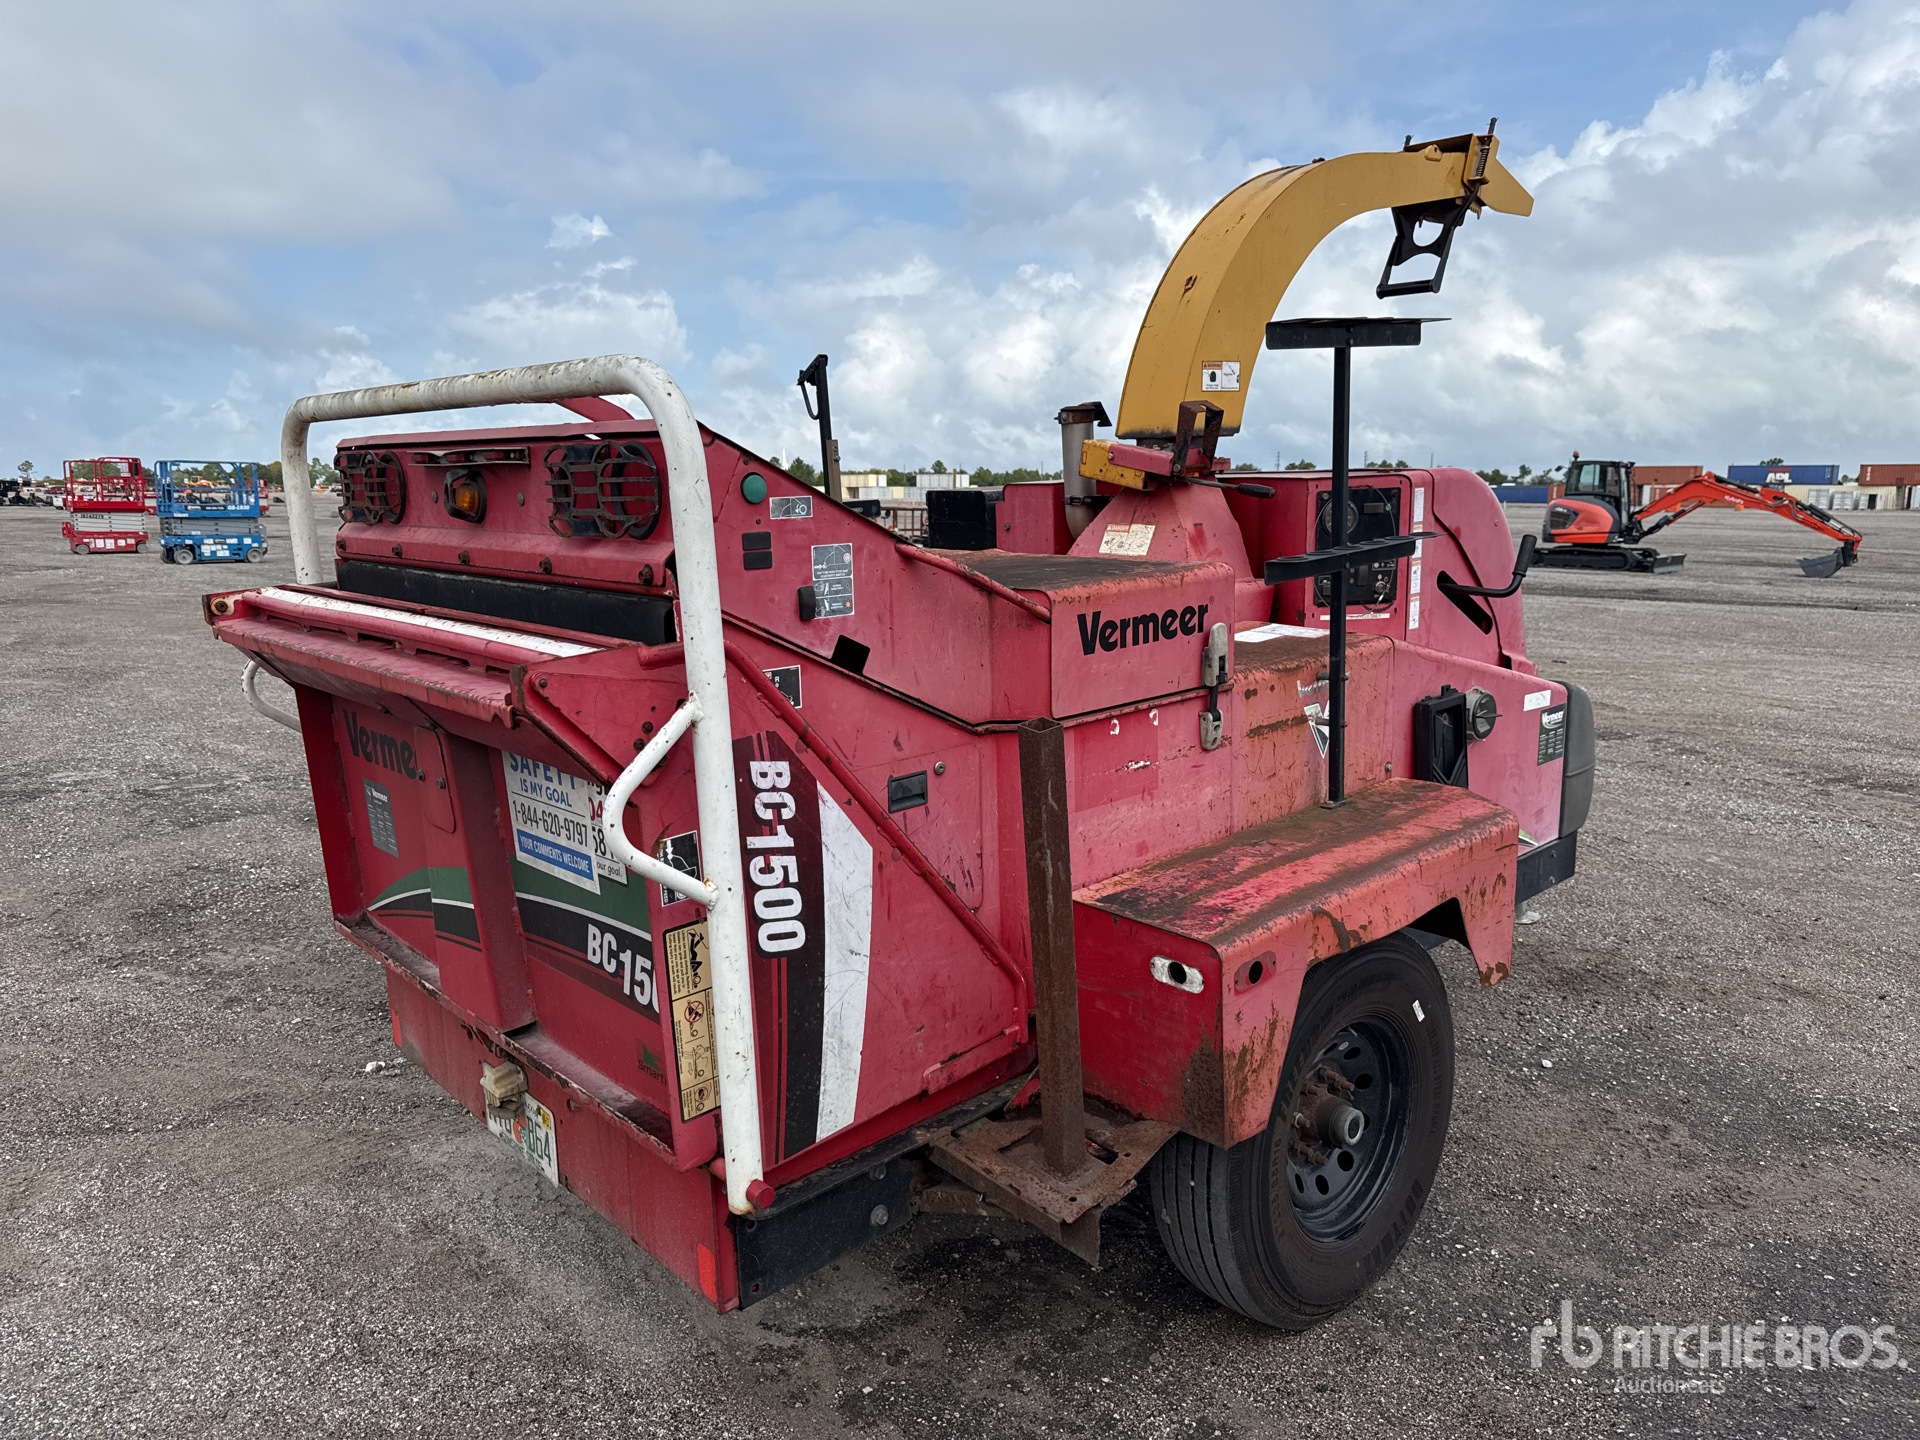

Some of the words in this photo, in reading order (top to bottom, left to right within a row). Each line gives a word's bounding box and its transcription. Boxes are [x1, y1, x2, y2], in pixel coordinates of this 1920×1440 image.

[1766, 473, 1792, 483] APL
[1078, 604, 1209, 656] Vermeer
[343, 709, 418, 779] Verme
[520, 778, 528, 792] IS
[530, 782, 543, 798] MY
[546, 786, 572, 808] GOAL
[512, 800, 588, 848] 1-844-620-9797
[520, 836, 533, 850] YOUR
[534, 840, 562, 862] COMMENTS
[562, 852, 590, 874] WELCOME
[608, 864, 623, 878] goal.
[746, 760, 806, 954] BC1500
